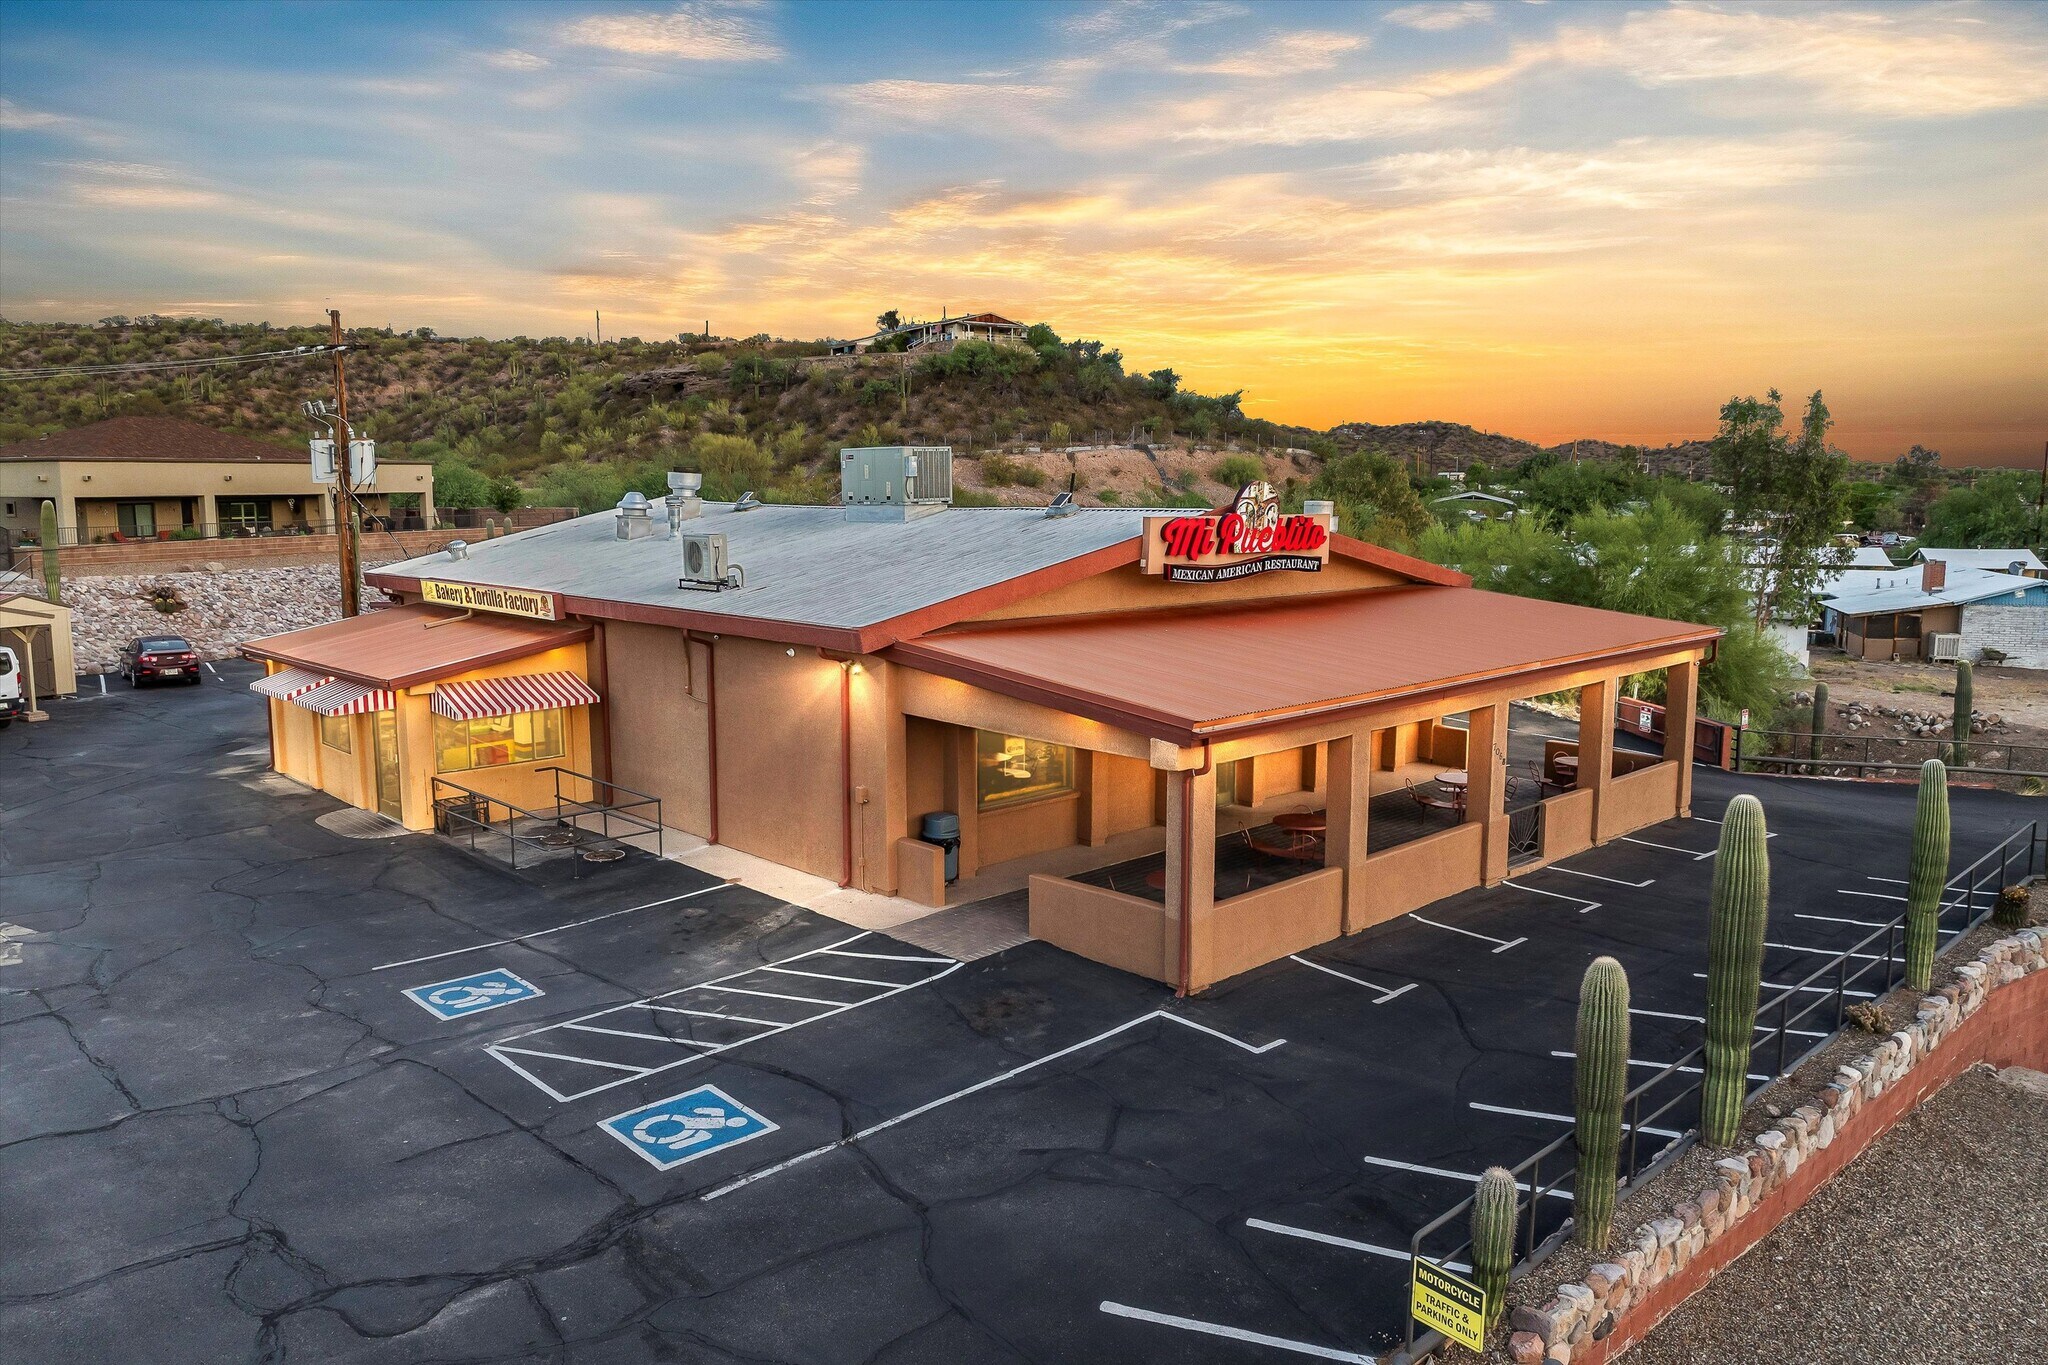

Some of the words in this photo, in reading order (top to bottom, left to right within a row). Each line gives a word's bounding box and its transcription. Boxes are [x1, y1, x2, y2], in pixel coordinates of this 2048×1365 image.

[1162, 517, 1215, 561] Mi
[1217, 513, 1327, 555] Pueblito
[1172, 568, 1214, 580] MEXICAN
[1216, 561, 1263, 579] AMERICAN
[1264, 558, 1319, 571] RESTAURANT
[434, 583, 463, 604] Bakery
[463, 586, 472, 604] &
[472, 587, 502, 609] Tortilla
[503, 591, 539, 615] Factory
[1418, 1267, 1480, 1309] MOTORCYCLE
[1416, 1301, 1454, 1329] PARKING
[1455, 1322, 1479, 1341] ONLY
[1425, 1292, 1460, 1319] TRAFFIC
[1462, 1313, 1469, 1325] &
